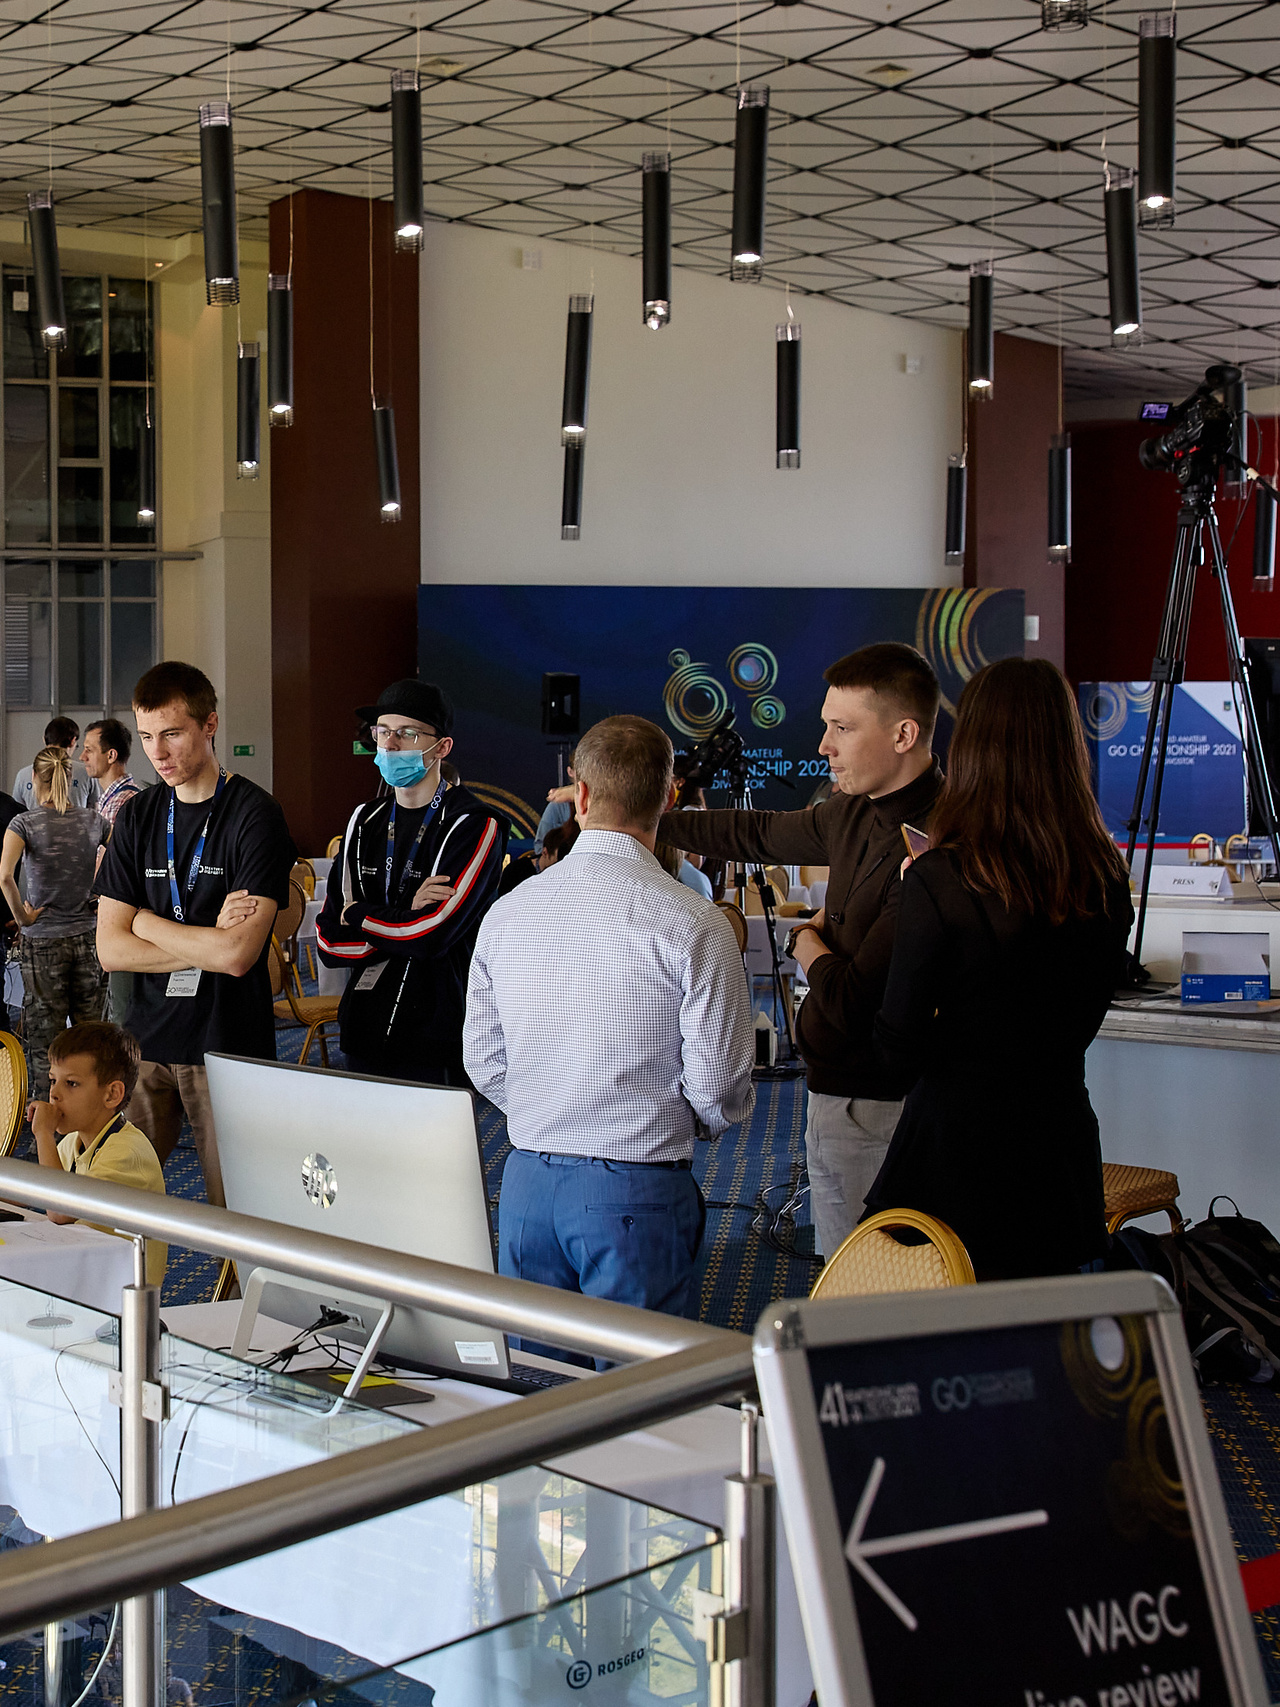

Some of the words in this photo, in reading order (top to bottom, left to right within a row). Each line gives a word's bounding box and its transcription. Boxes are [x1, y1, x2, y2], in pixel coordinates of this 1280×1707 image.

[741, 748, 783, 758] MATEUR
[1108, 745, 1128, 757] GO
[1213, 743, 1237, 756] 2021
[798, 760, 830, 777] 202
[1065, 1584, 1189, 1658] WAGC
[597, 1648, 645, 1677] ROSGEO
